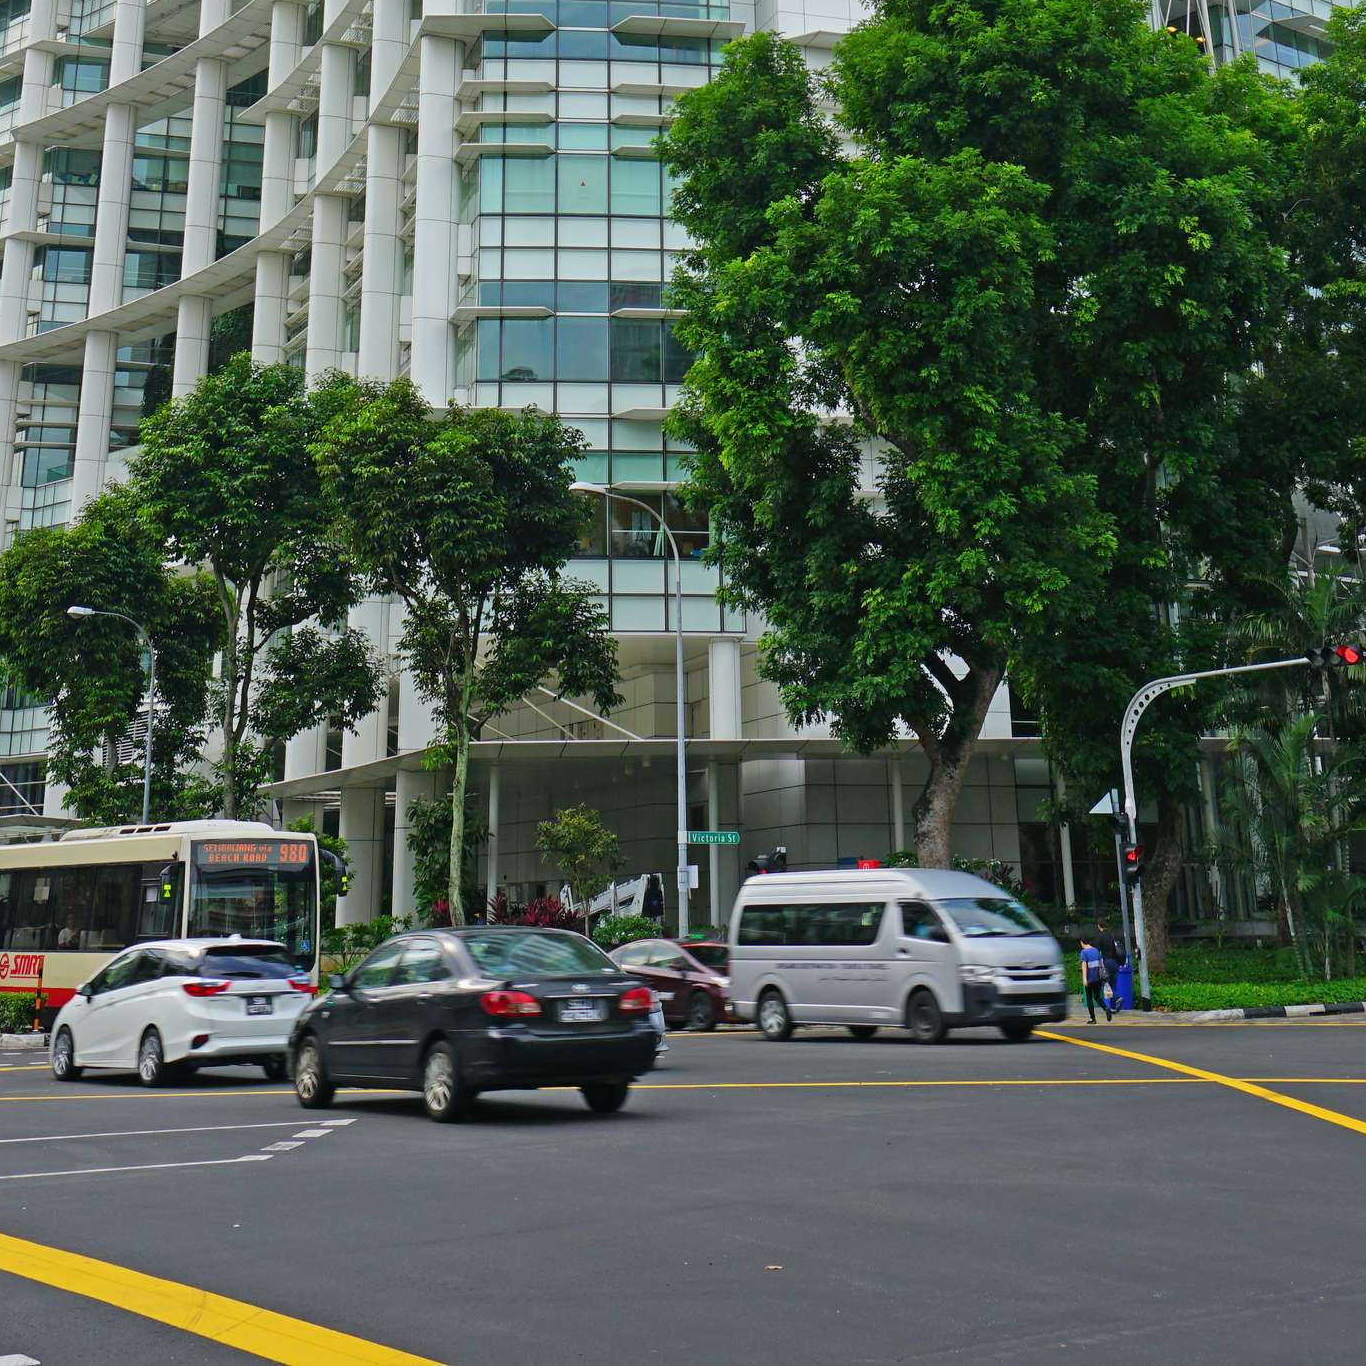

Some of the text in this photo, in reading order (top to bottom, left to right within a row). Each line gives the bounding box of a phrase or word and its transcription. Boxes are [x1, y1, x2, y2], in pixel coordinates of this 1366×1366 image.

[692, 833, 736, 843] Victoria St
[279, 842, 309, 863] 980
